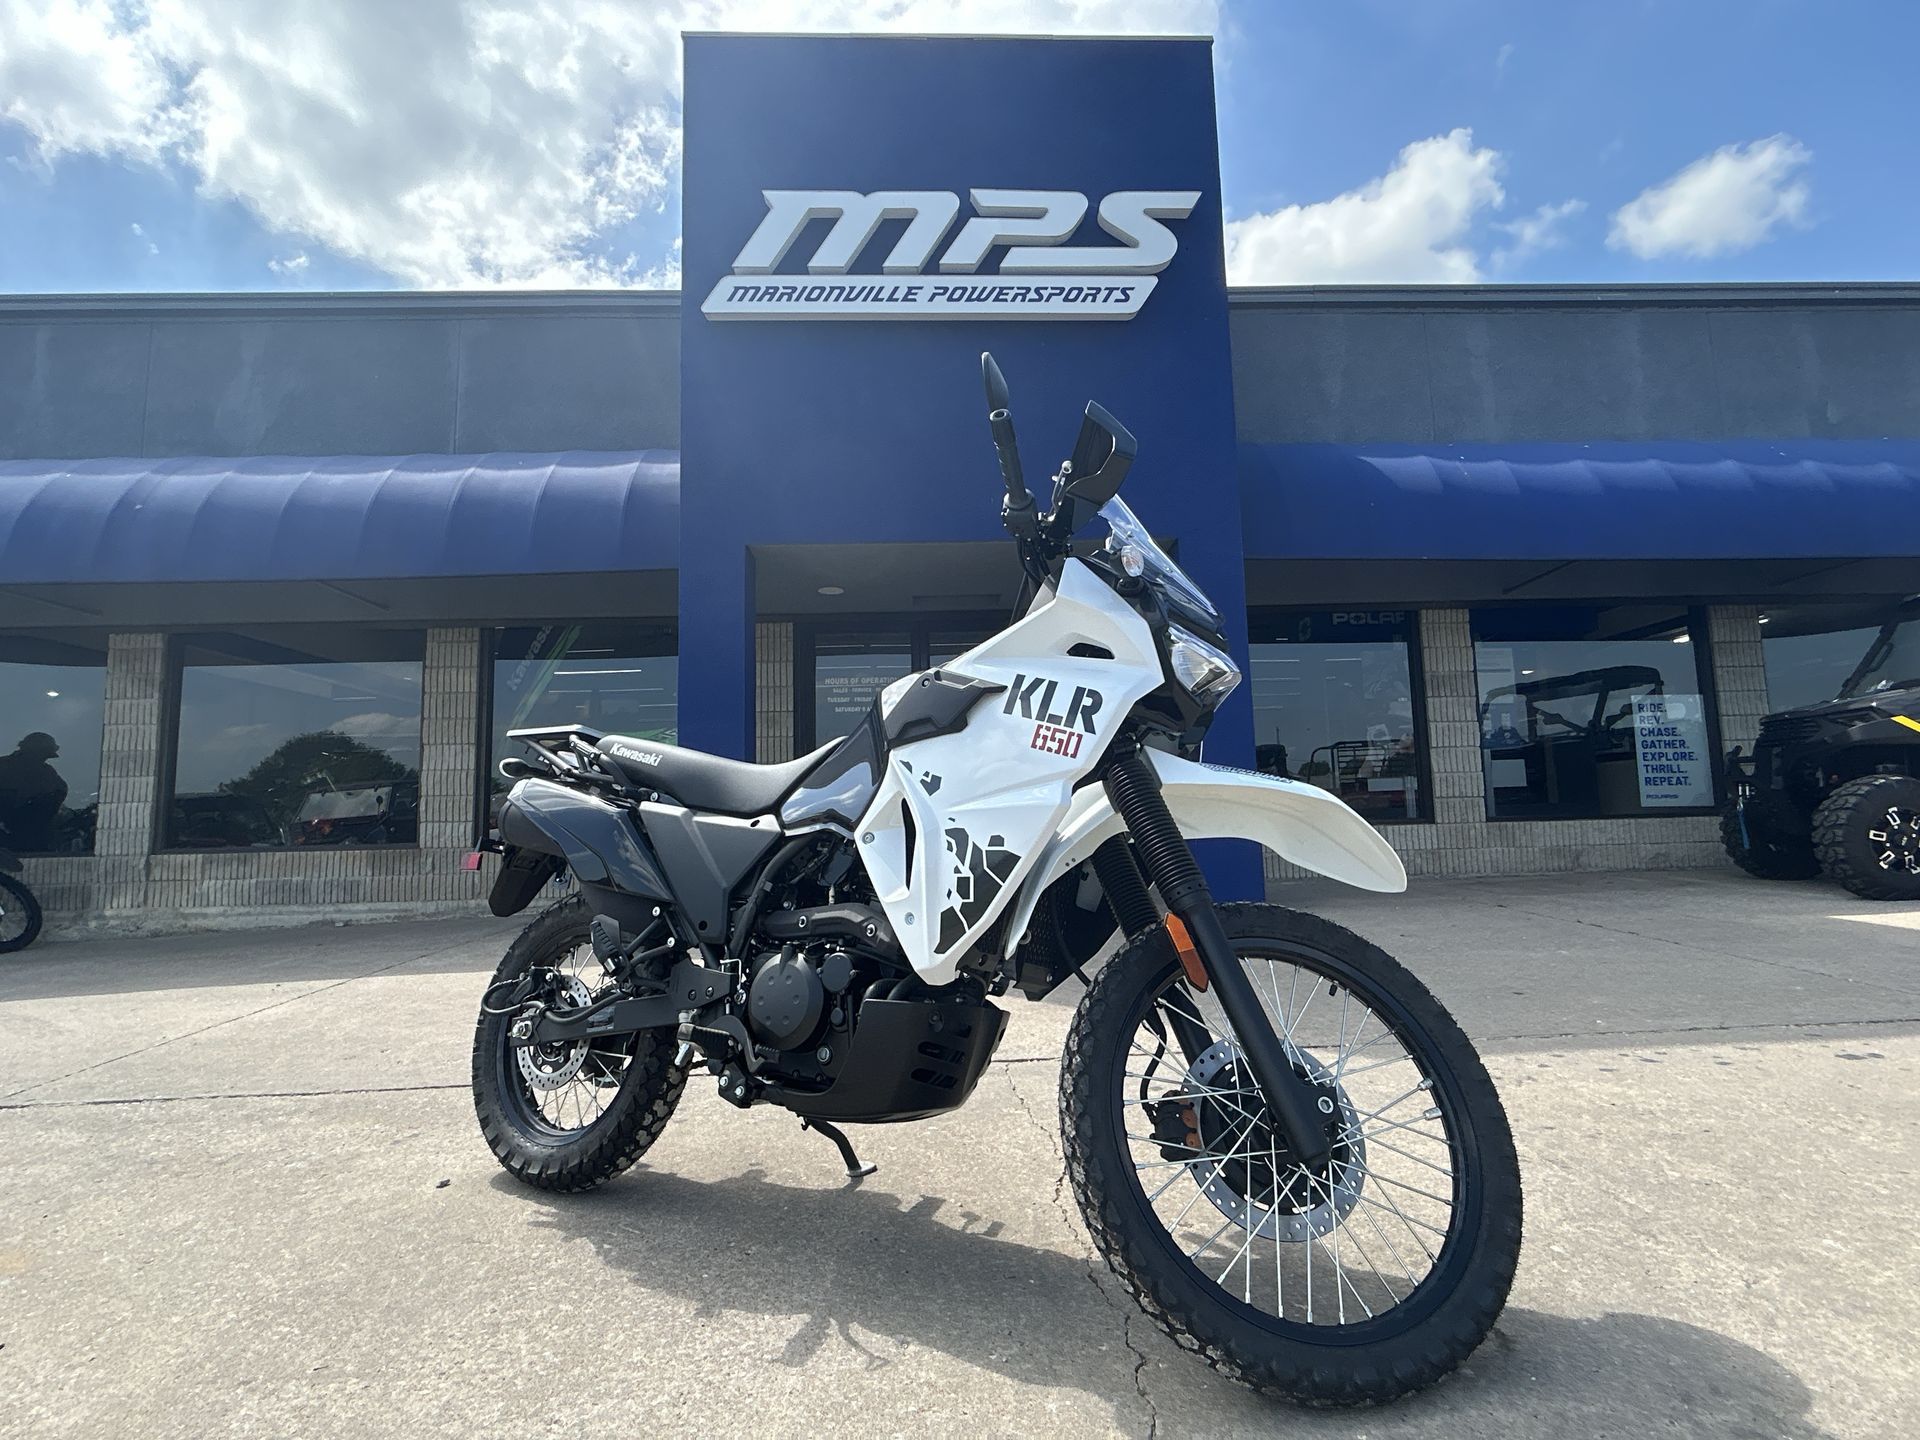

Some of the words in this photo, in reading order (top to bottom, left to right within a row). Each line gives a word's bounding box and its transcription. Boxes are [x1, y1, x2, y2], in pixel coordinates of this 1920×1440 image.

[732, 188, 1202, 275] MPS
[727, 285, 922, 304] MARIONVILLE
[927, 285, 1136, 304] POWERSPORTS
[824, 677, 849, 685] HOURS
[850, 677, 859, 685] OF
[860, 677, 898, 685] OPERATIO
[1003, 673, 1103, 735] KLR
[1638, 703, 1667, 713] RIDE.
[1640, 716, 1664, 725] REV.
[1640, 727, 1681, 737] CHASE.
[1030, 724, 1083, 759] 650
[1641, 740, 1690, 749] GATHER.
[609, 742, 663, 767] Kawasaki
[1642, 752, 1698, 761] EXPLORE.
[1644, 764, 1687, 774] THRILL.
[1645, 776, 1692, 786] REPEAT.
